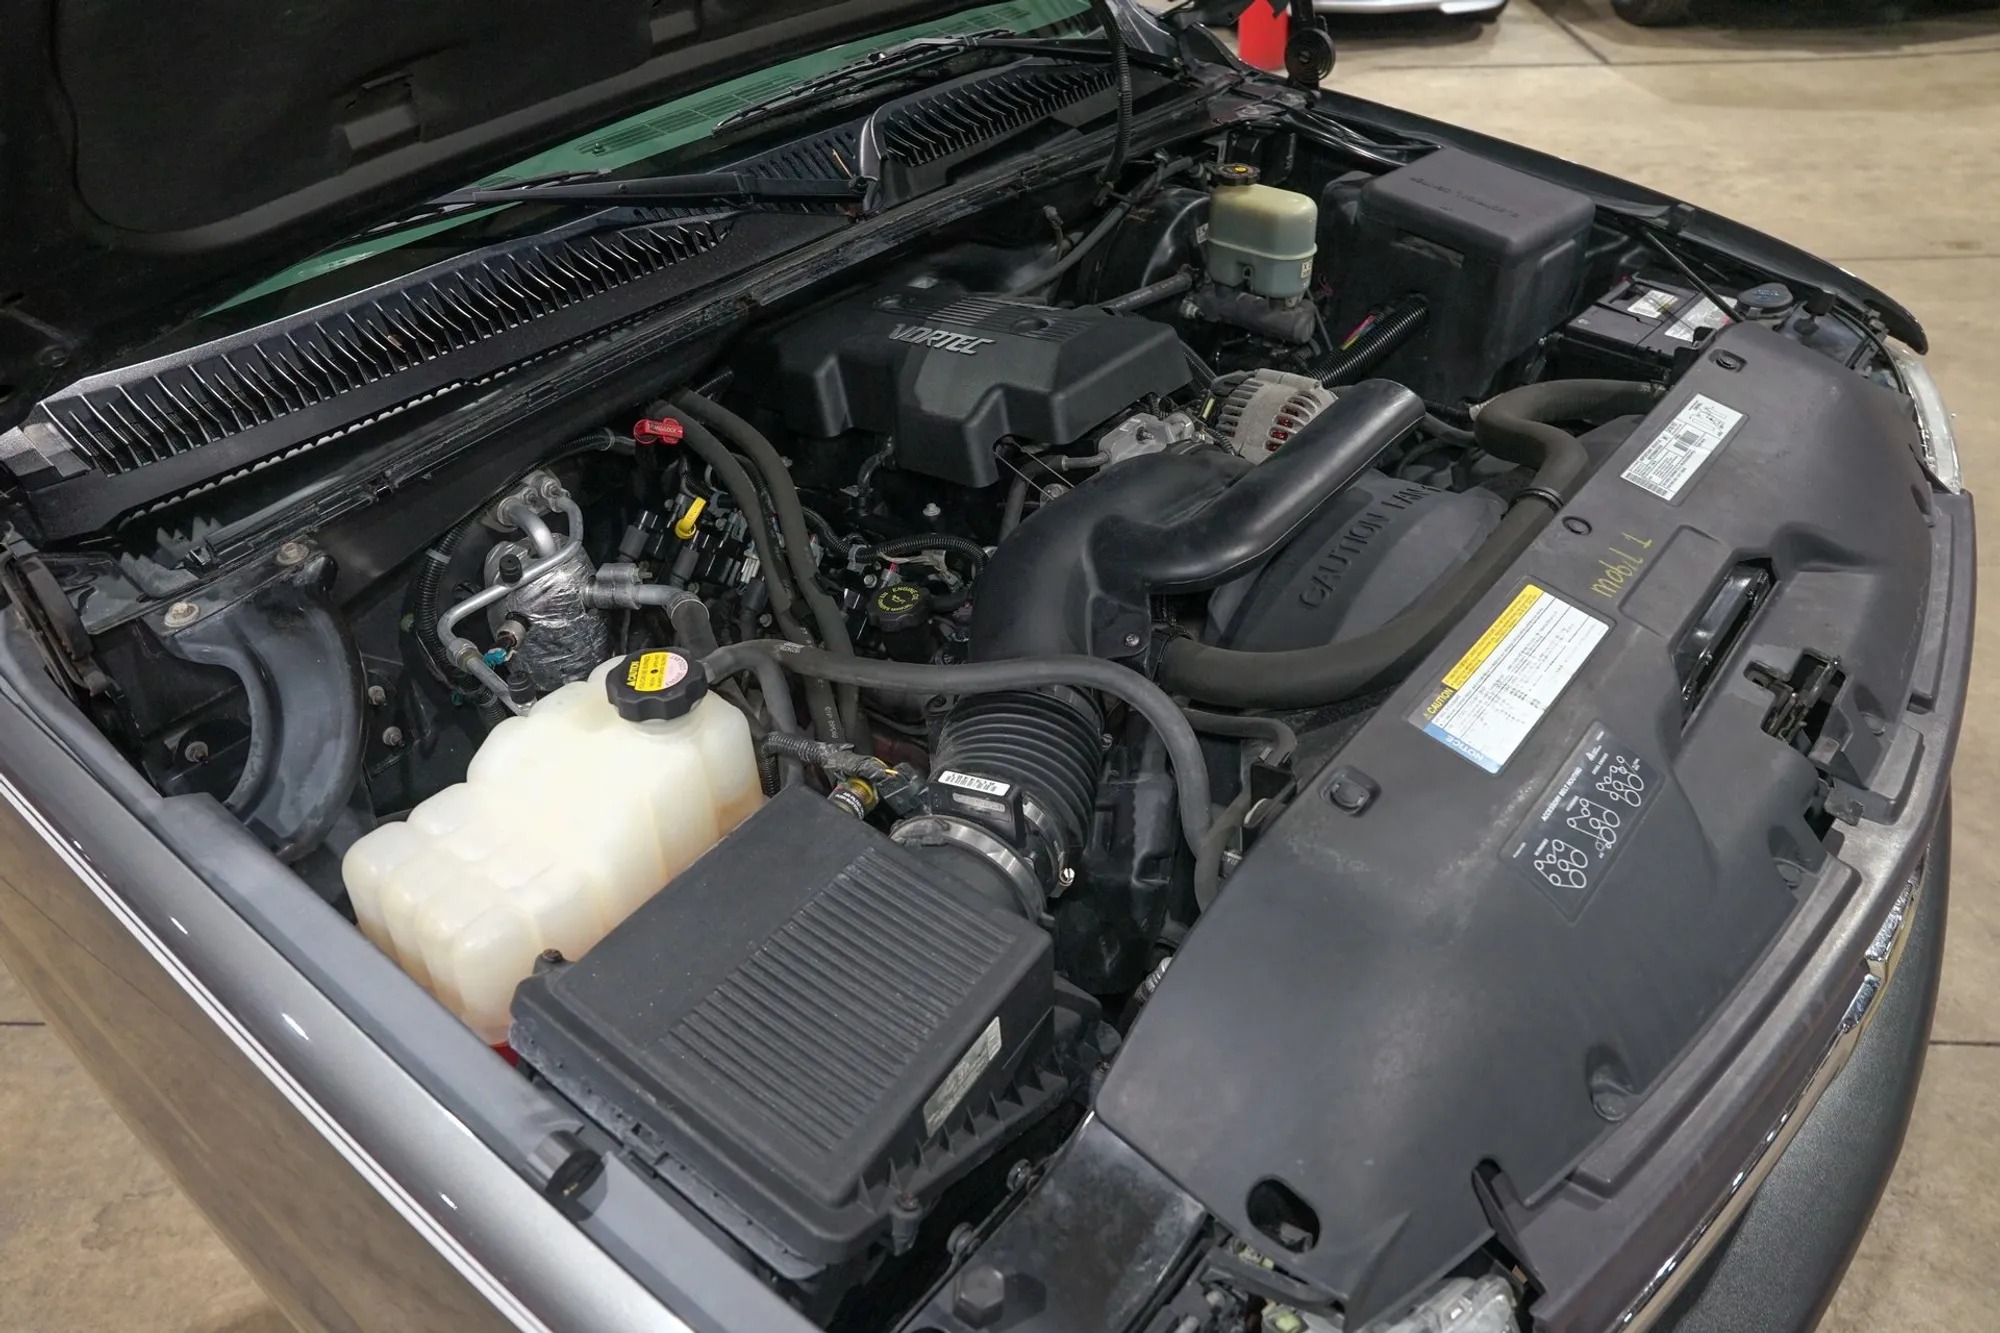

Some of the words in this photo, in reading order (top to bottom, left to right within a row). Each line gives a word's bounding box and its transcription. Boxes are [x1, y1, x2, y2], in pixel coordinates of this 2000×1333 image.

[889, 323, 996, 355] VORTEC
[1299, 512, 1391, 610] CAUTION
[1427, 687, 1454, 714] CAUTION
[1446, 735, 1484, 761] NOTICE
[1558, 784, 1570, 797] BELT
